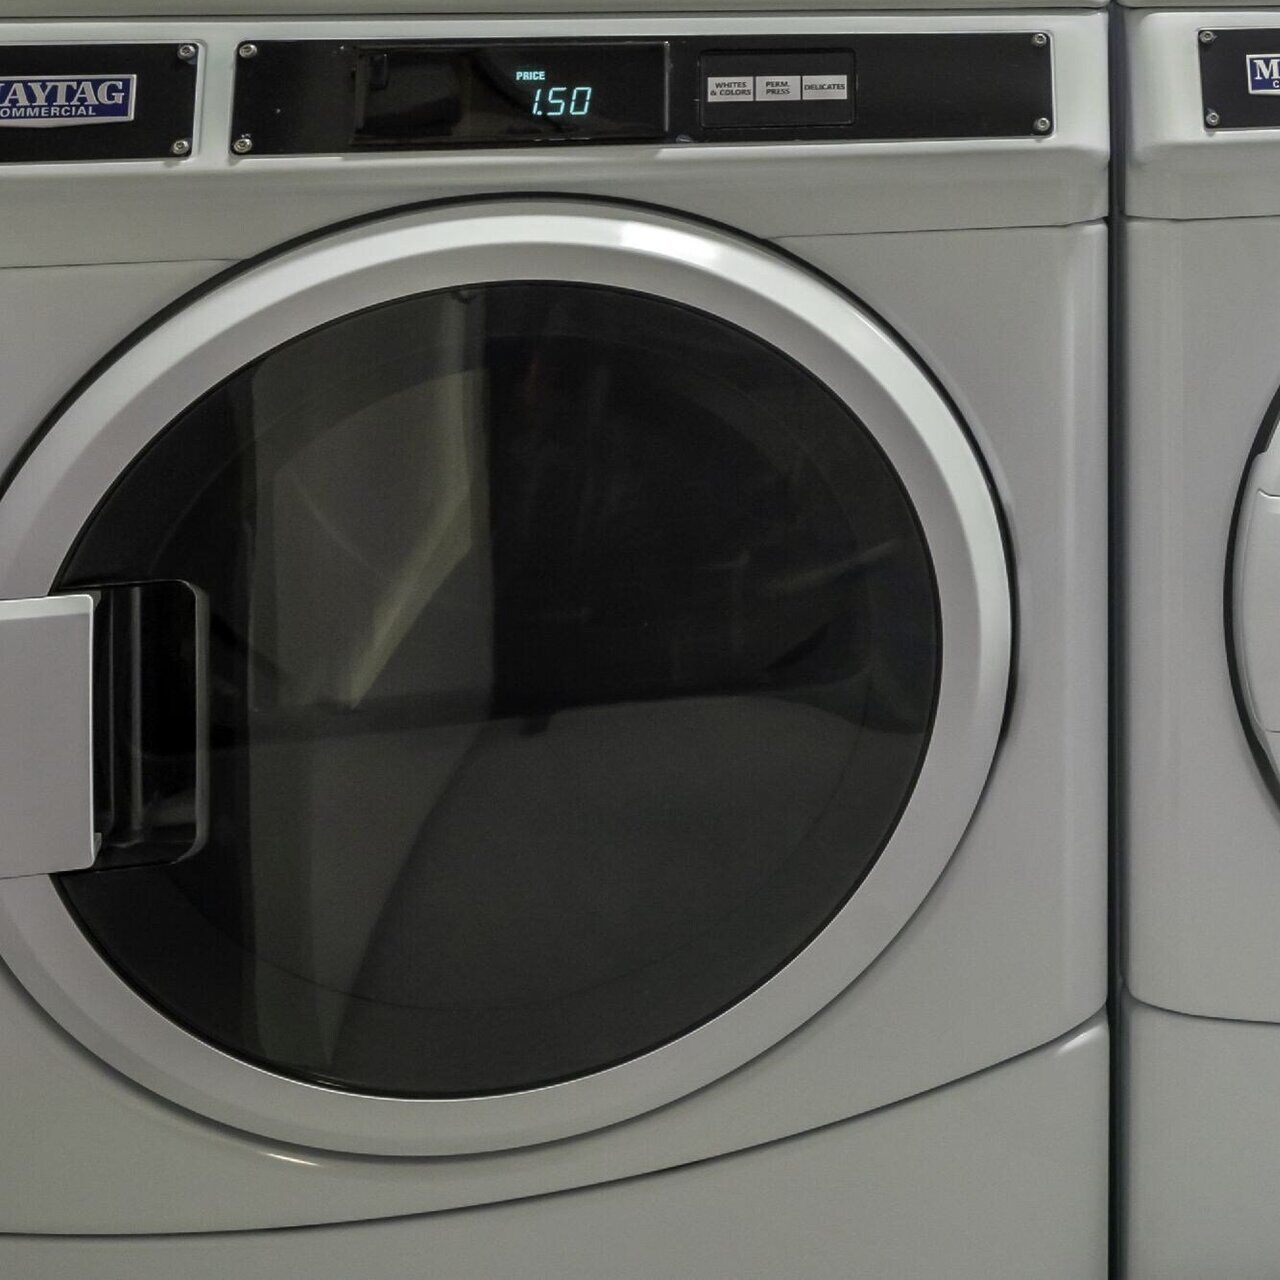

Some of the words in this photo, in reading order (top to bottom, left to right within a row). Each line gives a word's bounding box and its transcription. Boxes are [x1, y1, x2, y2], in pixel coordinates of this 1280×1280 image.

[516, 71, 546, 81] PRICE
[715, 81, 747, 89] WHITES
[0, 81, 125, 107] AYTAG
[532, 87, 592, 116] 1.50
[0, 106, 97, 118] OMMERCIAL
